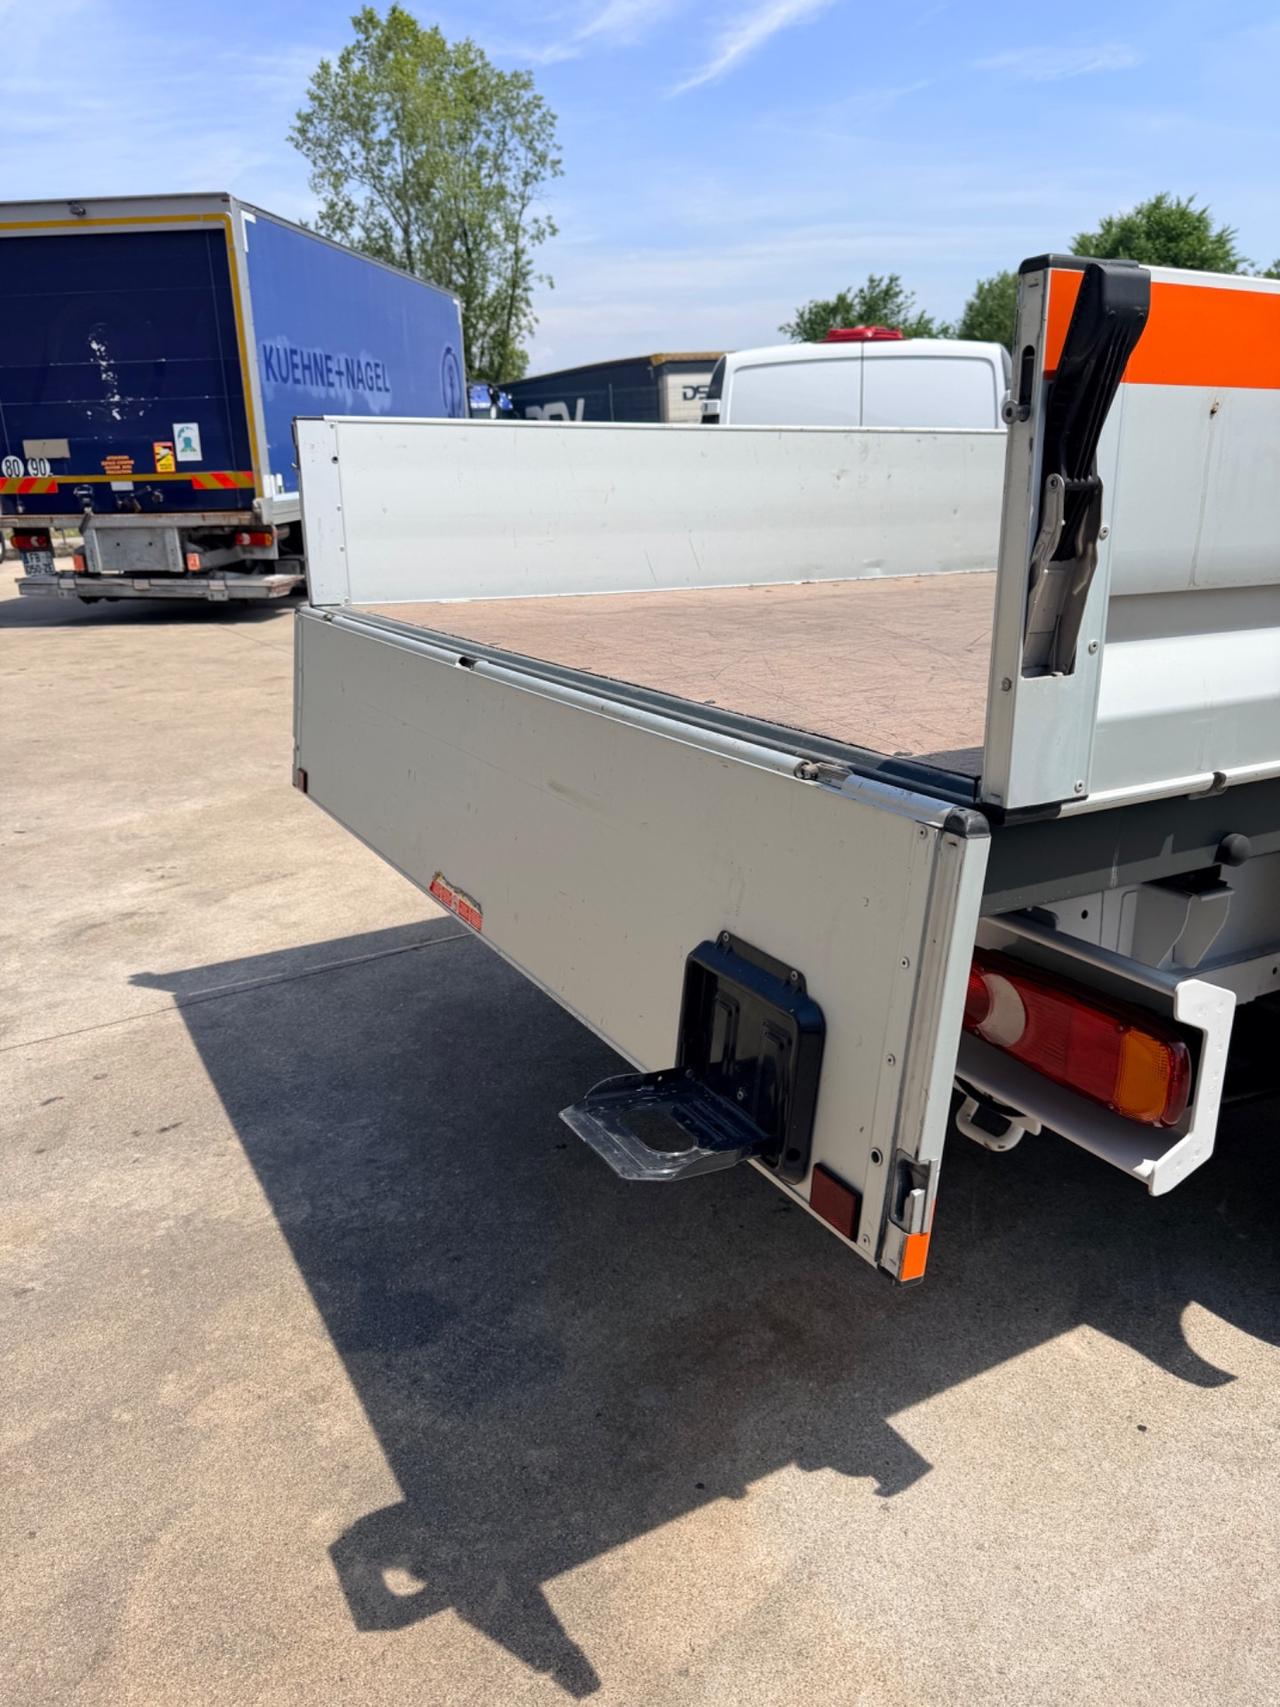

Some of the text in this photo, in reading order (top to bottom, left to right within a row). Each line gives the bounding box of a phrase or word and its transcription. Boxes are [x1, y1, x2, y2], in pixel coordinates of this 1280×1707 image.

[262, 343, 391, 393] KUEHNE+NAGEL
[682, 385, 711, 401] DS
[5, 458, 21, 478] 80
[30, 457, 47, 477] 90
